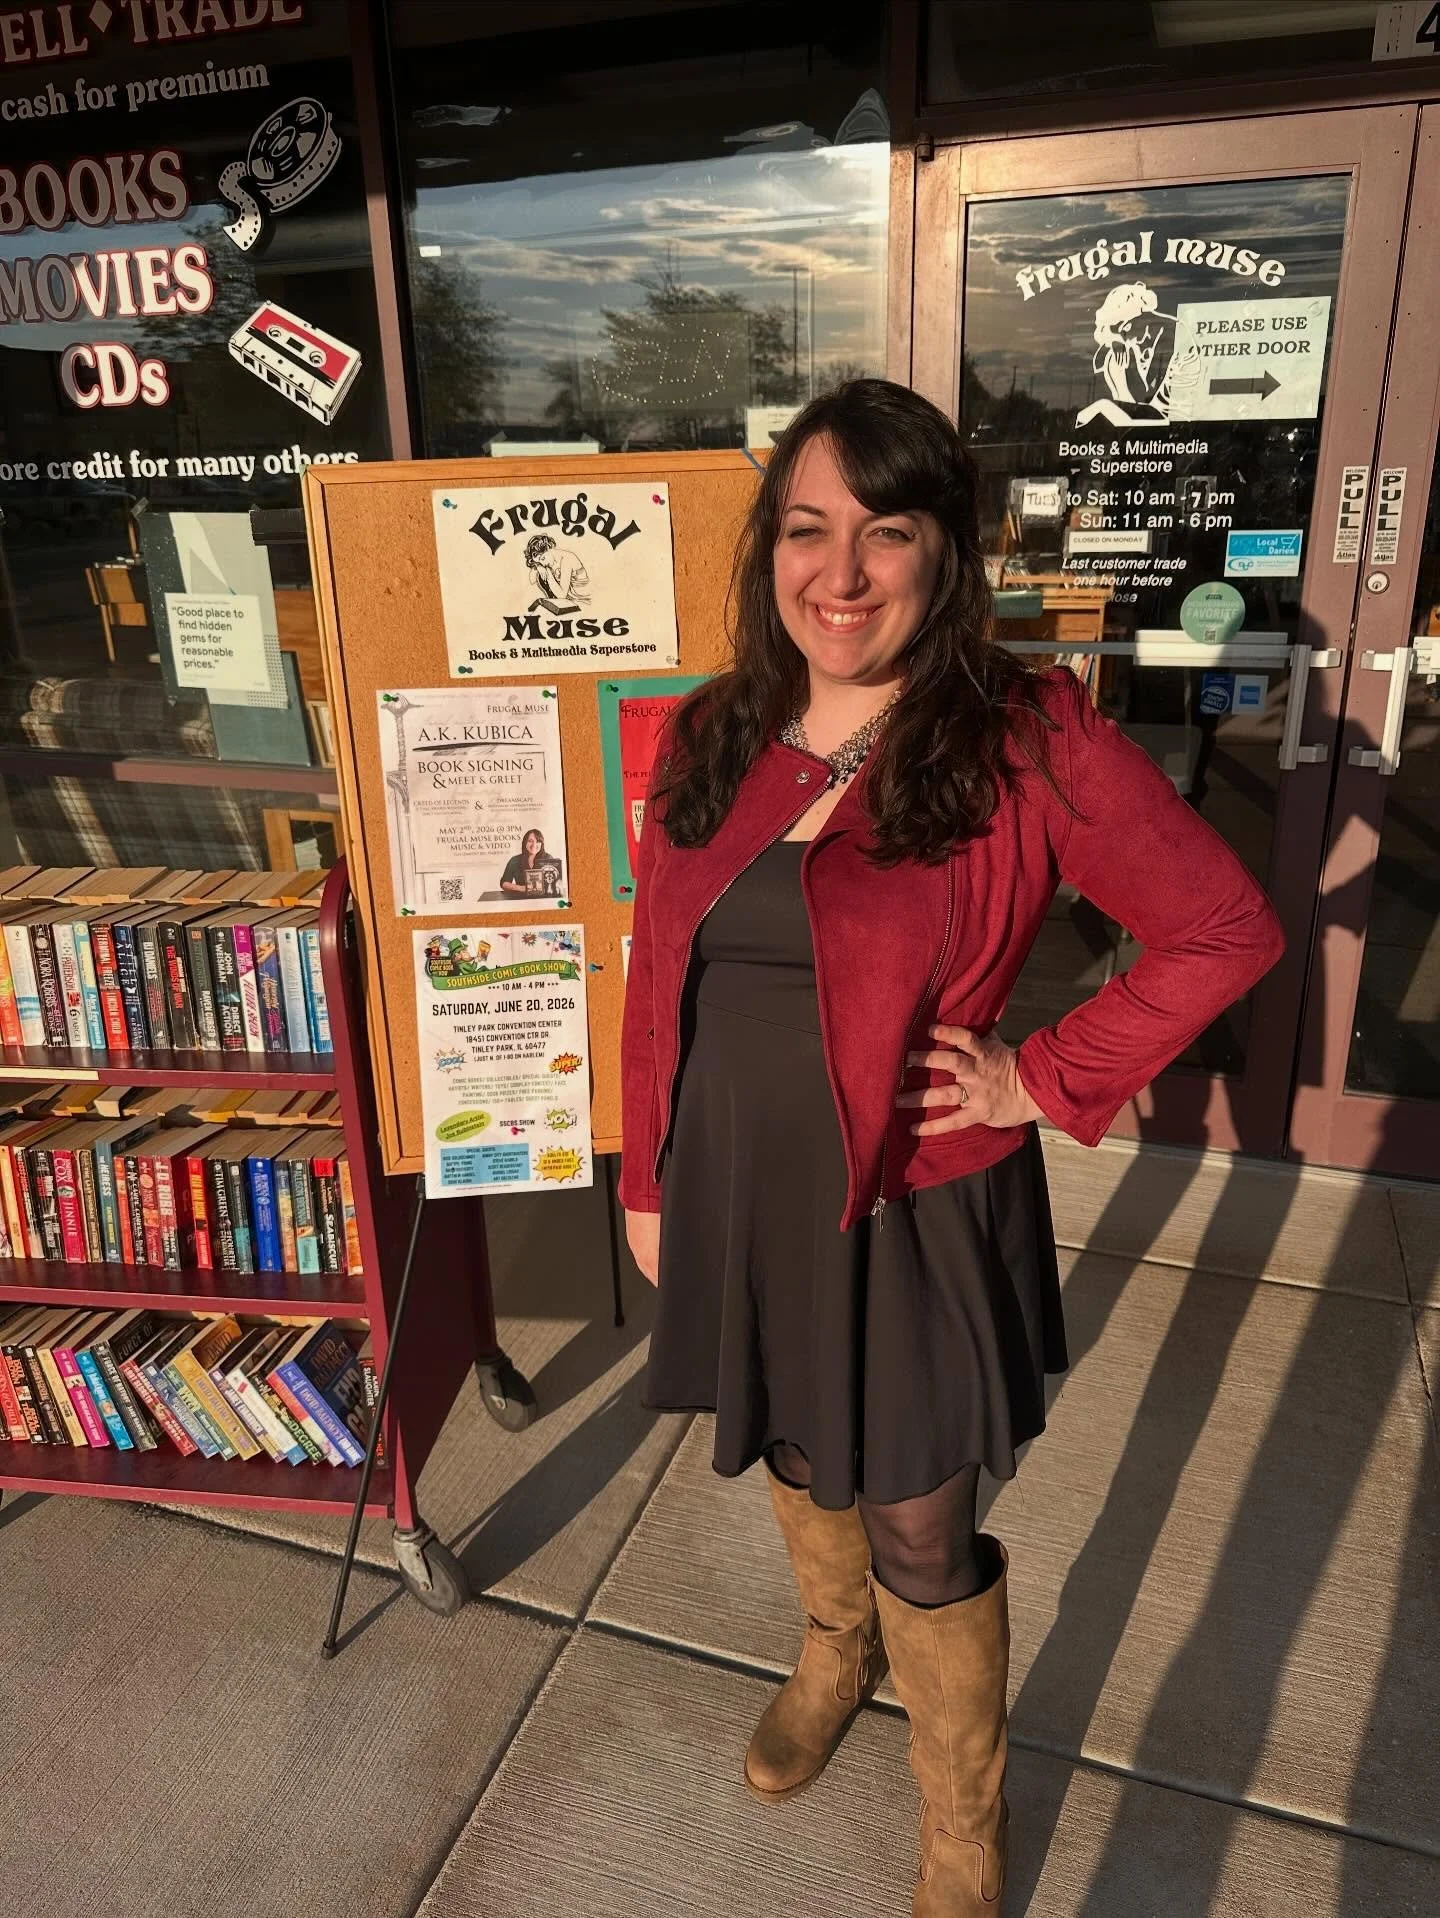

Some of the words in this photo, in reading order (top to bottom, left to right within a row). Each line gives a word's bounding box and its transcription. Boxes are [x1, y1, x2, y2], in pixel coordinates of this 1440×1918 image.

[1, 83, 69, 121] cash
[75, 78, 118, 112] for
[126, 60, 270, 112] premium
[0, 151, 189, 233] BOOKS
[1015, 231, 1155, 301] frugal
[1163, 238, 1287, 288] muse
[0, 244, 213, 323] MOVIES
[1196, 319, 1265, 334] PLEASE
[1271, 316, 1308, 330] USE
[1257, 340, 1311, 355] DOOR
[59, 341, 170, 409] CDs
[1058, 441, 1108, 457] Books
[1111, 441, 1121, 456] &
[1124, 440, 1209, 456] Multimedia
[47, 453, 122, 481] credit
[130, 450, 169, 478] for
[177, 451, 255, 482] many
[1090, 459, 1173, 474] Superstore
[1066, 491, 1081, 506] to
[1086, 490, 1119, 506] Sat:
[1125, 490, 1144, 506] 10
[1149, 492, 1175, 506] am
[1191, 492, 1201, 508] 7
[1207, 491, 1235, 508] pm
[1340, 474, 1364, 529] PULL
[1377, 475, 1402, 531] PULL
[469, 492, 641, 556] Frugal
[1080, 512, 1118, 529] Sun:
[1122, 512, 1141, 528] 11
[1147, 514, 1173, 528] am
[1189, 512, 1201, 528] 6
[1205, 513, 1233, 531] pm
[1256, 538, 1278, 547] Local
[1268, 546, 1295, 555] Darien
[1062, 557, 1089, 570] Last
[1091, 558, 1151, 570] customer
[1153, 557, 1187, 570] trade
[1073, 576, 1097, 586] one
[1100, 574, 1130, 586] hour
[1131, 573, 1173, 587] before
[1106, 591, 1138, 603] lose
[206, 608, 231, 620] place
[234, 608, 245, 618] to
[179, 619, 197, 630] find
[199, 620, 232, 631] hidden
[502, 615, 630, 641] Muse
[180, 634, 206, 645] gems
[208, 633, 222, 644] for
[182, 647, 234, 657] reasonable
[469, 649, 507, 661] Books
[510, 648, 519, 659] &
[521, 645, 587, 658] Multimedia
[590, 642, 657, 657] Superstore
[487, 704, 521, 713] FRUGAL
[525, 704, 550, 712] MUSE
[418, 726, 457, 742] A.K.
[464, 725, 534, 741] KUBICA
[418, 760, 463, 774] BOOK
[468, 758, 534, 773] SIGNING
[433, 773, 448, 789] &
[448, 776, 477, 785] MEET
[489, 774, 522, 784] GREET
[437, 836, 468, 844] FRUGAL
[485, 842, 511, 850] VIDEO
[96, 934, 112, 965] TERMINAL
[166, 945, 176, 959] THE
[38, 957, 54, 978] NORA
[143, 950, 158, 980] DANIELS
[168, 959, 179, 983] WINDS
[214, 944, 227, 983] WEISMAN
[223, 951, 234, 975] JOHN
[102, 966, 115, 987] FREEZE
[447, 973, 490, 988] SOUTHSIDE
[492, 968, 517, 980] COMIC
[520, 964, 541, 975] BOOK
[543, 962, 566, 973] SHOW
[42, 978, 58, 1007] ROBERTS
[172, 983, 181, 993] OF
[502, 983, 510, 991] 10
[511, 983, 522, 991] AM
[534, 981, 545, 989] PM
[174, 992, 184, 1009] WAR
[201, 990, 213, 1011] RAVEN
[432, 1002, 491, 1017] SATURDAY,
[494, 1000, 522, 1013] JUNE
[547, 997, 575, 1010] 2026
[221, 1004, 233, 1036] ACTION
[231, 1006, 241, 1034] DIRECT
[453, 1025, 476, 1033] TINLEY
[478, 1023, 496, 1032] PARK
[497, 1022, 537, 1031] CONVENTION
[538, 1020, 562, 1028] CENTER
[465, 1035, 485, 1043] 18451
[486, 1033, 525, 1042] CONVENTION
[527, 1032, 539, 1040] CTR
[471, 1046, 495, 1054] TINLEY
[525, 1042, 546, 1050] 60477
[54, 1157, 68, 1183] COX
[99, 1164, 113, 1197] HEIRESS
[215, 1172, 225, 1190] TIM
[157, 1184, 174, 1217] ROBB
[217, 1192, 228, 1217] GREEN
[324, 1213, 339, 1269] SEABISCUIT
[363, 1367, 375, 1407] SLAUGHTER
[290, 1421, 323, 1460] DEGREE
